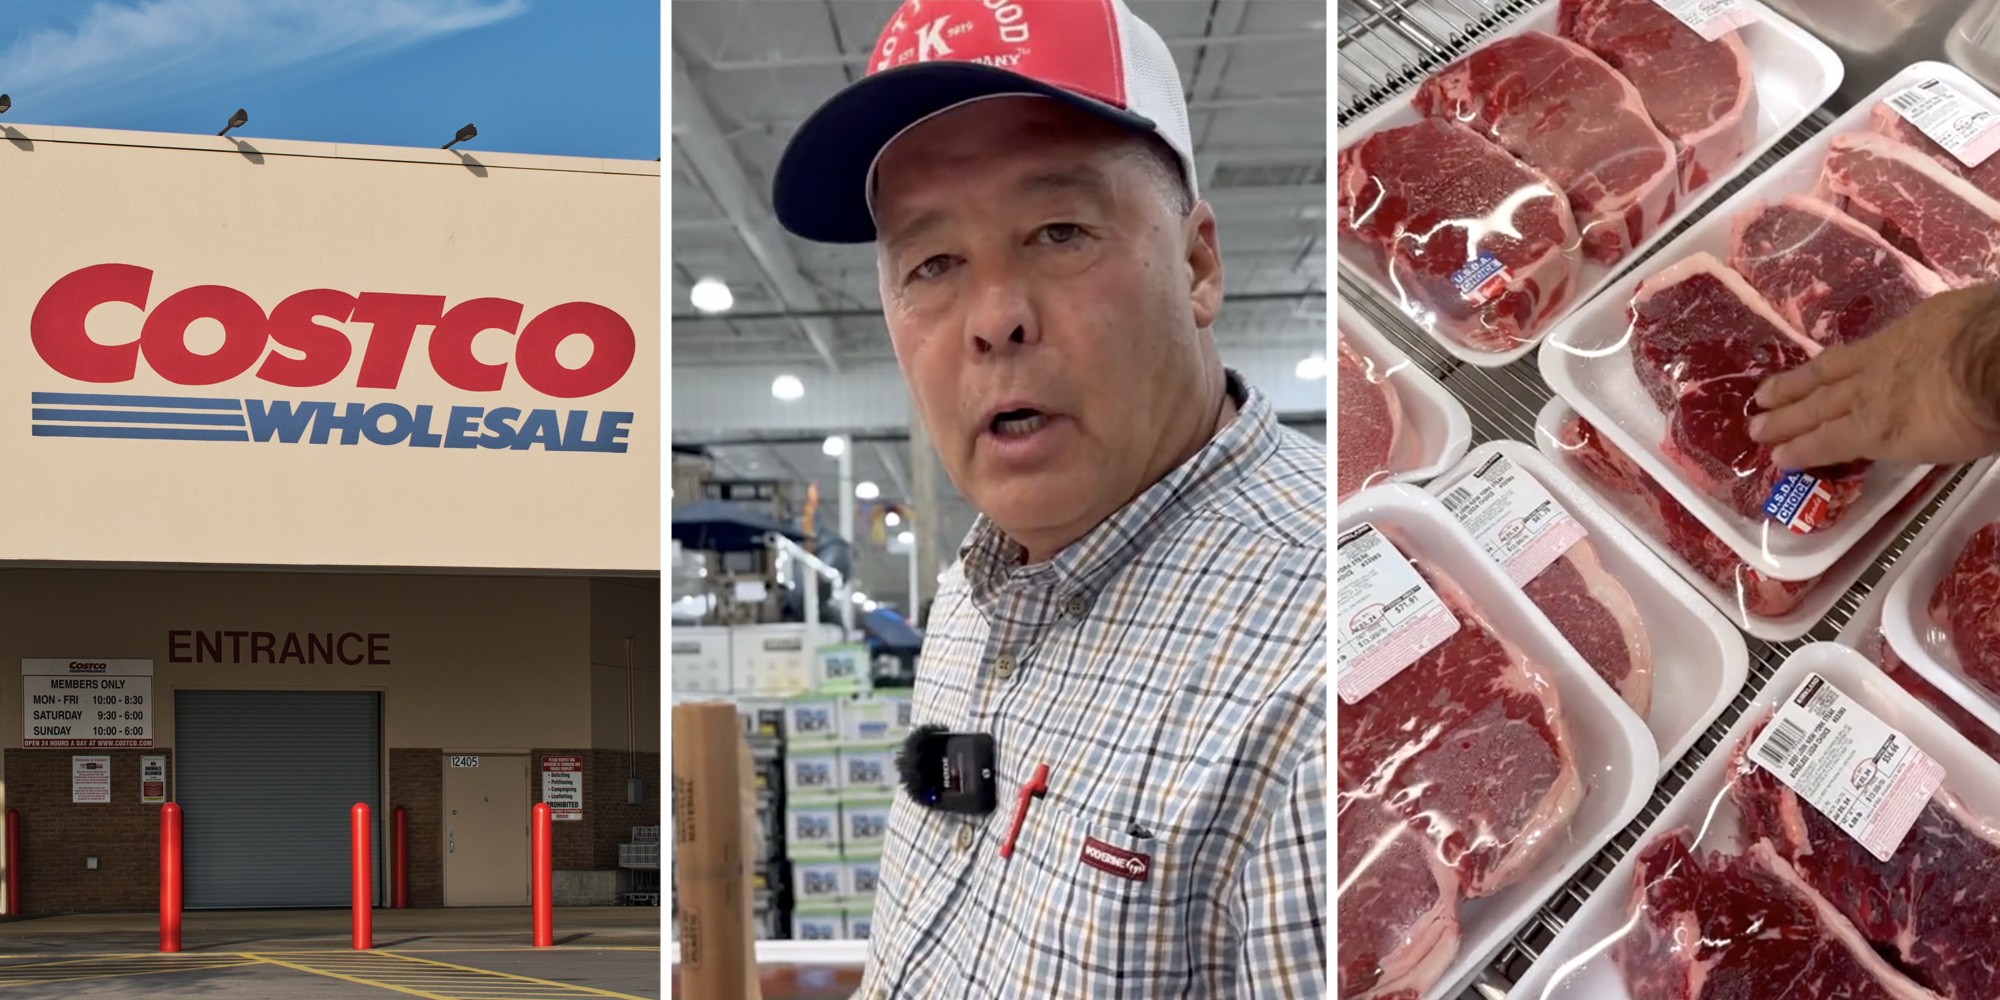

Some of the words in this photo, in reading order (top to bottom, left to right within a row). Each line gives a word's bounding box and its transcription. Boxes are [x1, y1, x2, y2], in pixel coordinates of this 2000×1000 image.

[915, 14, 954, 62] K
[1463, 263, 1497, 289] CHOICE
[30, 263, 636, 399] COSTCO
[244, 399, 634, 454] WHOLESALE
[1767, 474, 1800, 513] U.S.D.A.
[1780, 478, 1811, 519] CHOICE
[1394, 593, 1419, 615] $71.91
[168, 630, 391, 666] ENTRANCE
[69, 661, 107, 670] COSTCO
[34, 695, 55, 704] MON
[64, 695, 79, 704] FRI
[93, 695, 116, 704] 10:00
[124, 696, 143, 704] 8:30
[51, 680, 98, 689] MEMBERS
[101, 680, 125, 689] ONLY
[34, 711, 83, 720] SATURDAY
[97, 711, 116, 720] 9:30
[124, 711, 143, 720] 6:00
[34, 726, 71, 735] SUNDAY
[93, 726, 116, 735] 10:00
[124, 727, 143, 735] 6:00
[1787, 753, 1800, 767] BEEF
[1795, 742, 1808, 756] LOIN
[1804, 731, 1817, 745] NEW
[1813, 719, 1826, 734] YORK
[1821, 706, 1836, 722] STEAK
[1789, 754, 1810, 778] BONELESS
[1805, 742, 1819, 757] USDA
[1815, 726, 1831, 744] CHOICE
[451, 756, 478, 767] 12405
